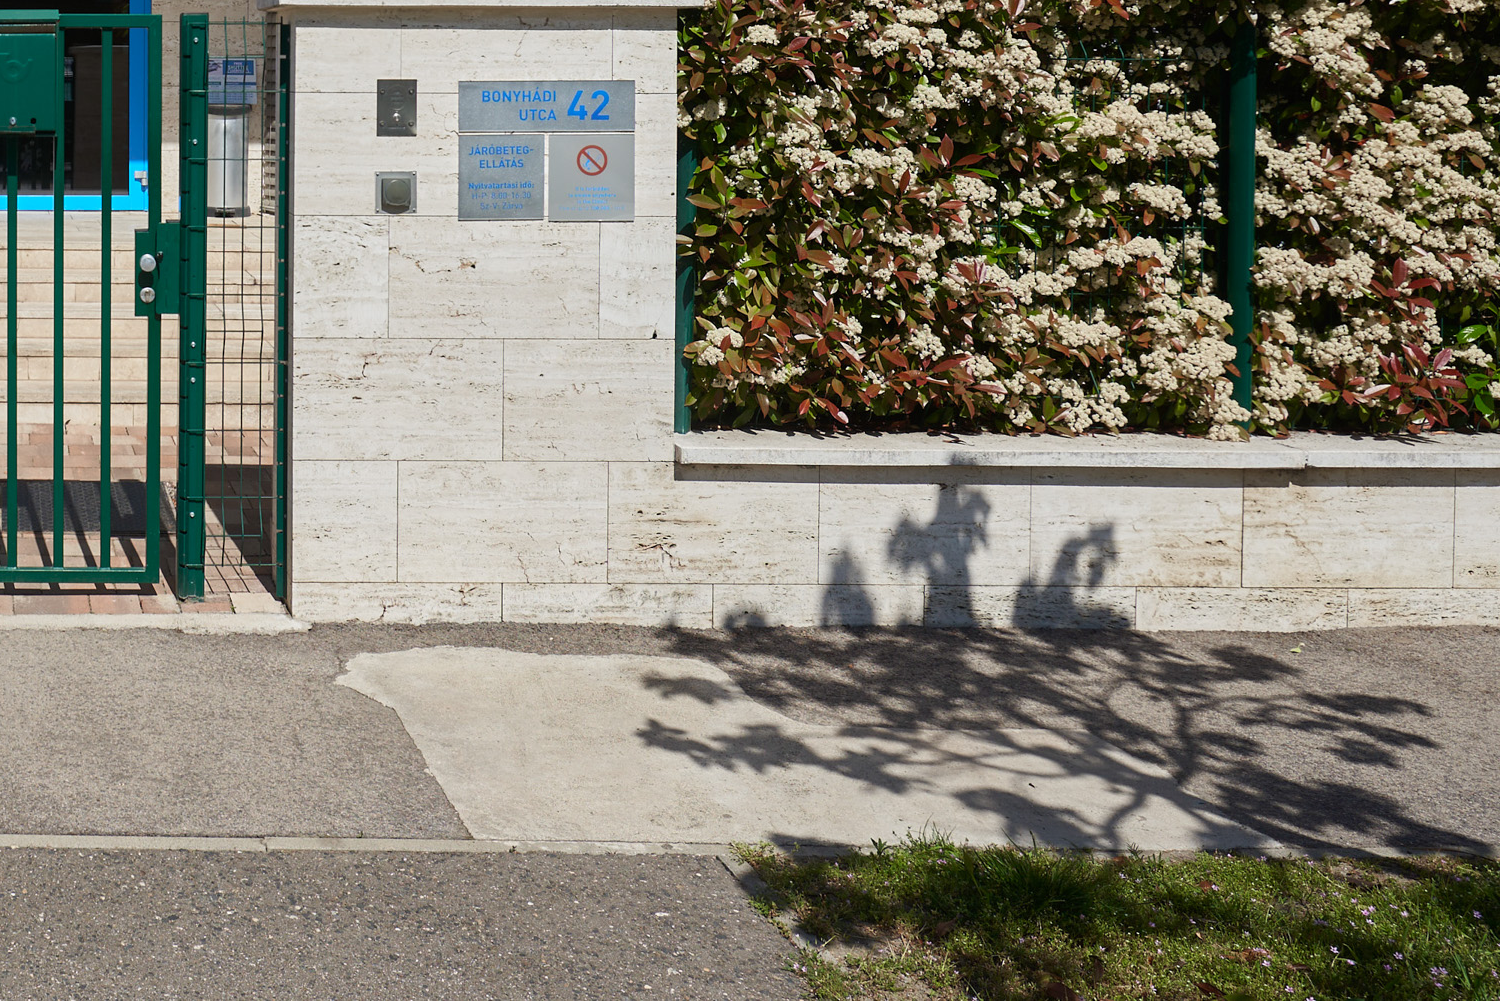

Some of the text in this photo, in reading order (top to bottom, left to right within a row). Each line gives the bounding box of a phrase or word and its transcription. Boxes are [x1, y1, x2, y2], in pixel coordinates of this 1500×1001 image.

[482, 87, 610, 121] BONYHÁDI 42
[519, 109, 557, 121] UTCA
[468, 144, 534, 156] JÁRÓBETEG-
[479, 157, 524, 169] ELLÁTÁS
